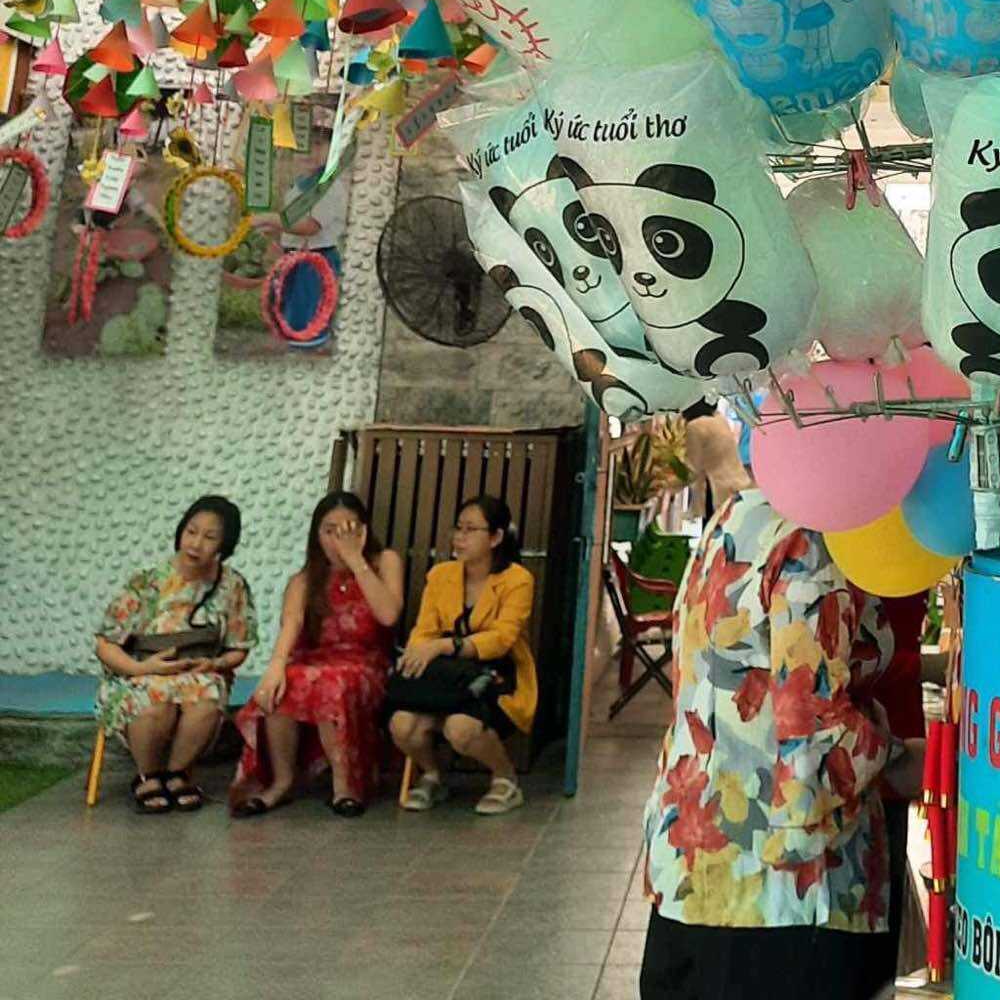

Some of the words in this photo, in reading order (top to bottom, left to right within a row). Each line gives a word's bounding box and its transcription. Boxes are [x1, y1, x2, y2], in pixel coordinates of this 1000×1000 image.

[465, 148, 482, 180] Ký
[484, 141, 501, 168] ức
[503, 111, 538, 156] tuổi
[543, 107, 564, 141] Ký
[567, 114, 591, 142] ức
[593, 108, 638, 143] tuổi
[645, 113, 688, 140] thơ
